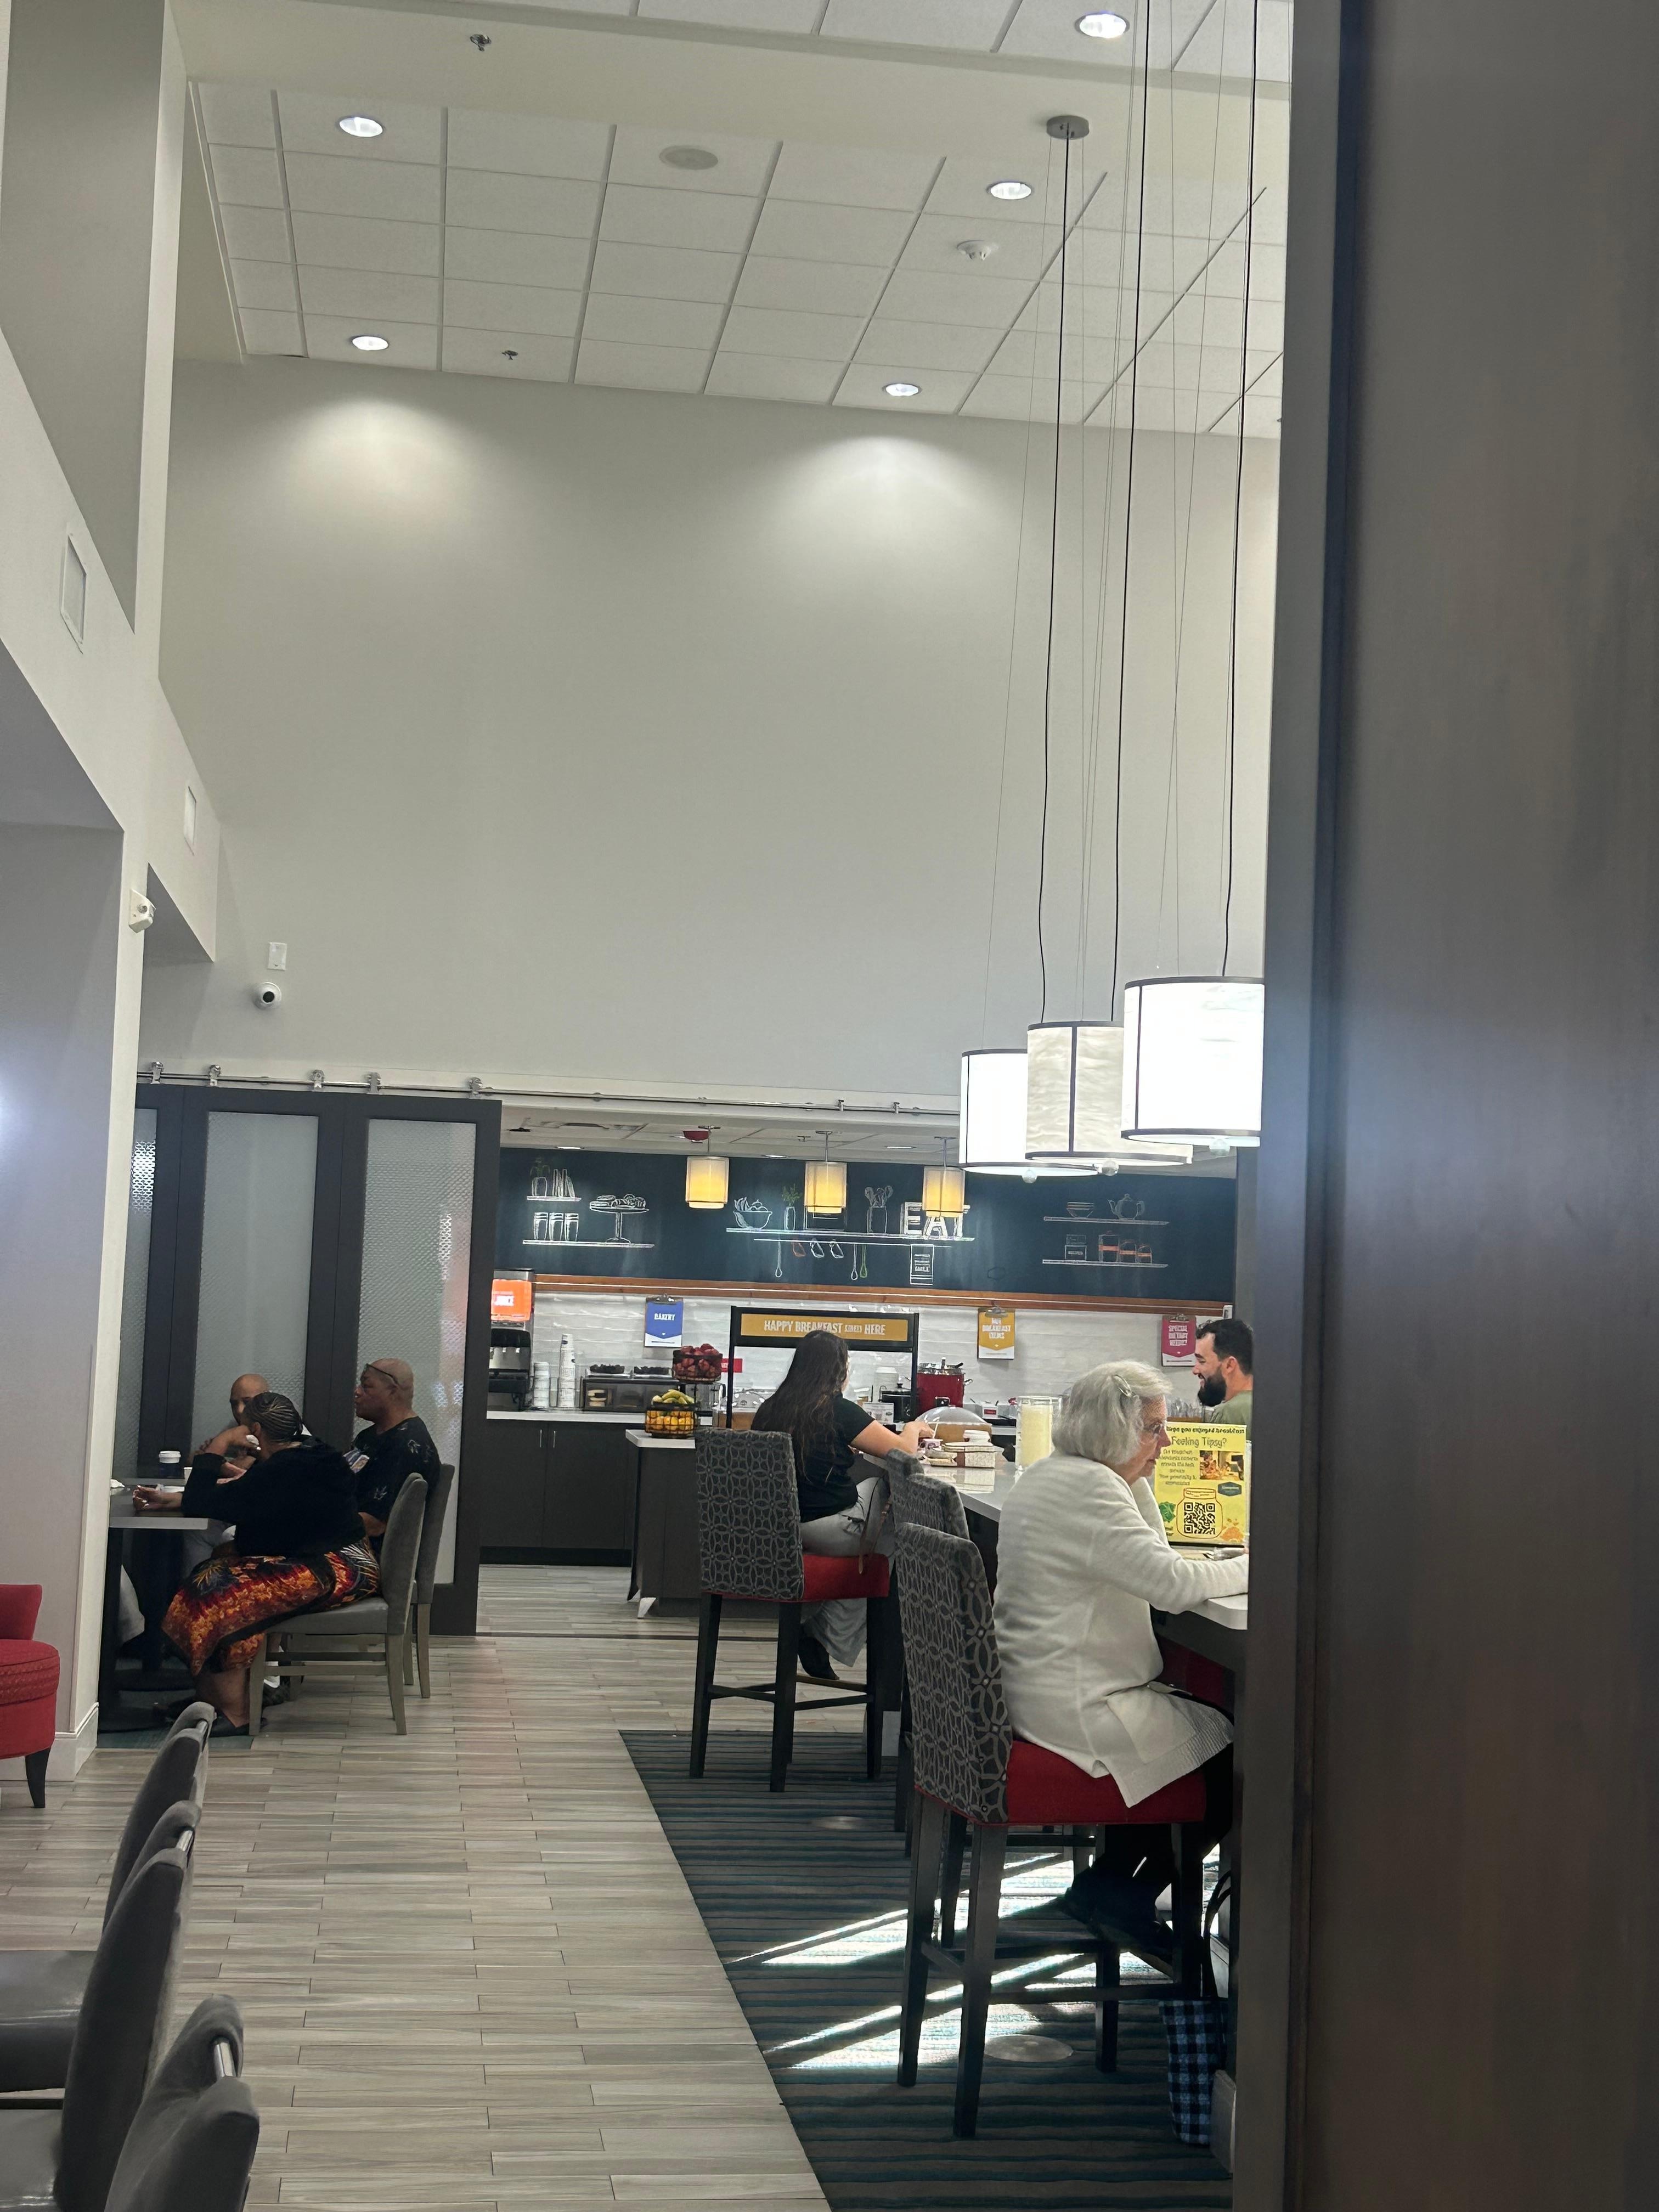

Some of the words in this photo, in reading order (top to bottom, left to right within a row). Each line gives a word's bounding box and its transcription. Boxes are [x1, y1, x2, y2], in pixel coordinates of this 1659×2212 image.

[654, 1313, 676, 1321] BAKERY
[764, 1320, 794, 1332] HAPPY
[795, 1322, 843, 1334] BREAKFAST
[864, 1324, 886, 1335] HERE
[1171, 1436, 1199, 1448] Feeling
[1201, 1437, 1227, 1449] Tipsy?
